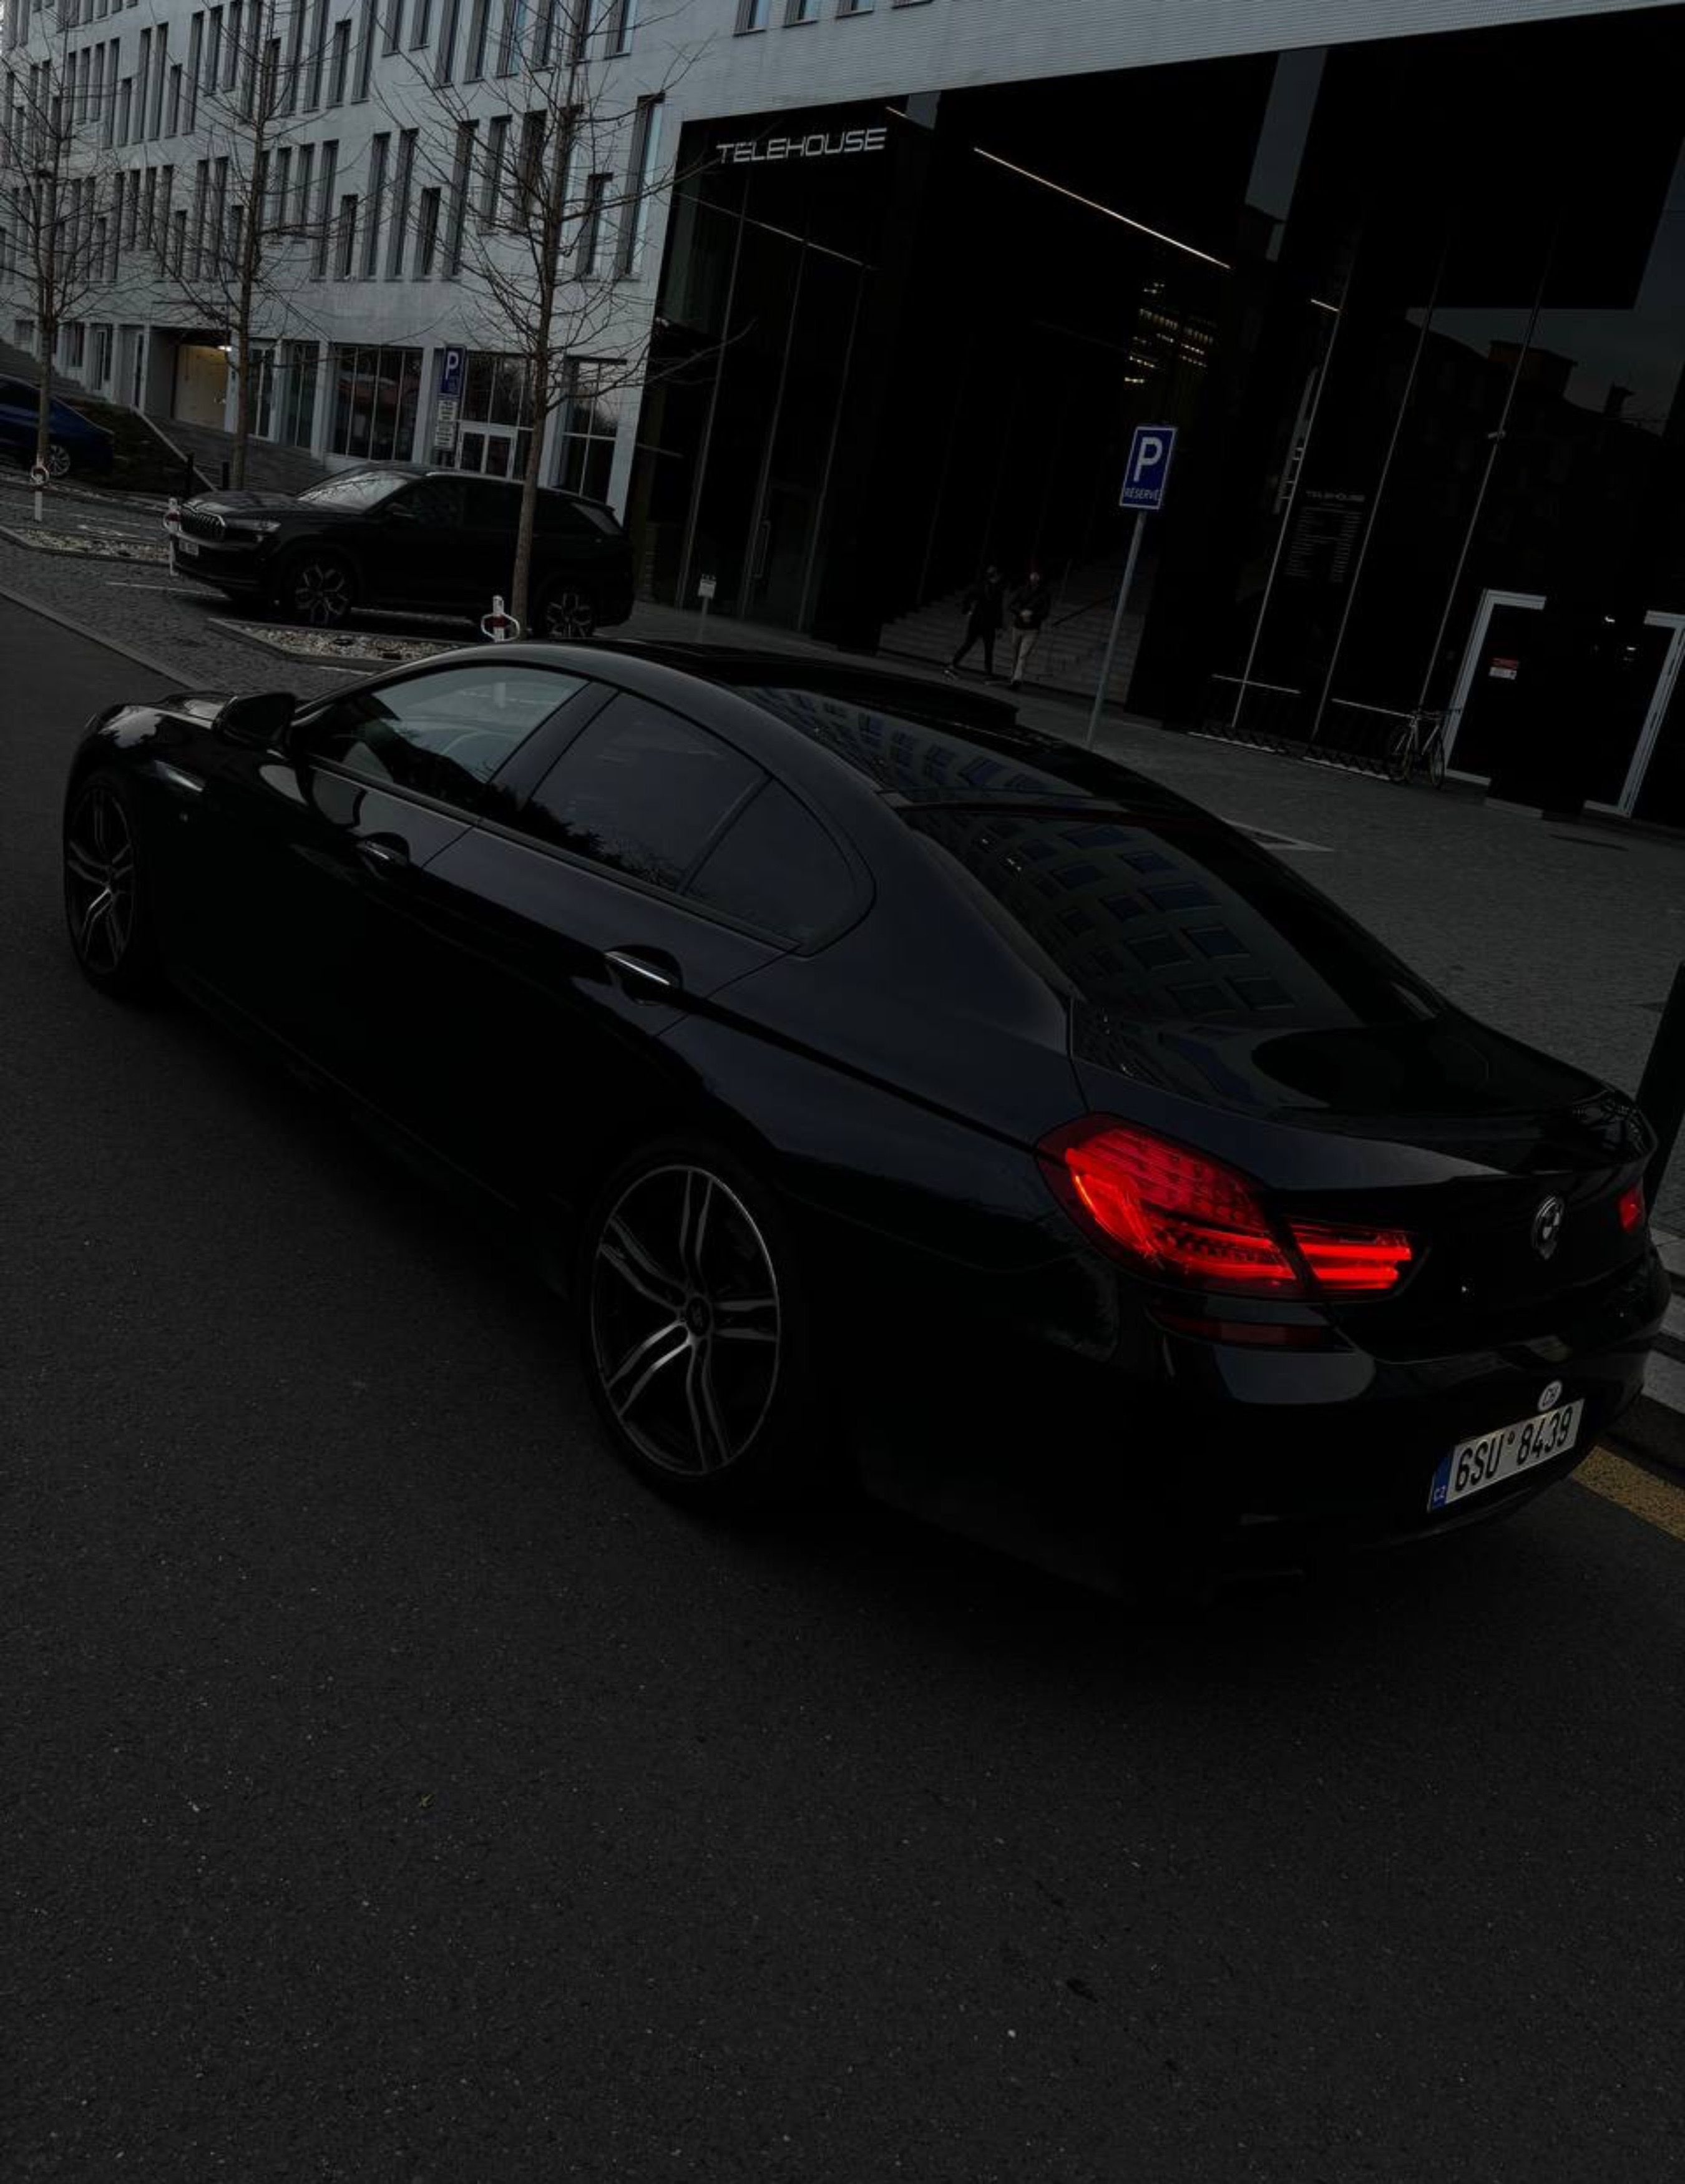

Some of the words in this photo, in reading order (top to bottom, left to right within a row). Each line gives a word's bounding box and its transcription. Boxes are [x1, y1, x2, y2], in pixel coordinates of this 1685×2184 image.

[715, 127, 888, 164] TELEHOUSE
[1133, 436, 1163, 484] P
[1456, 1434, 1505, 1491] 6SU
[1518, 1406, 1573, 1466] 8439
